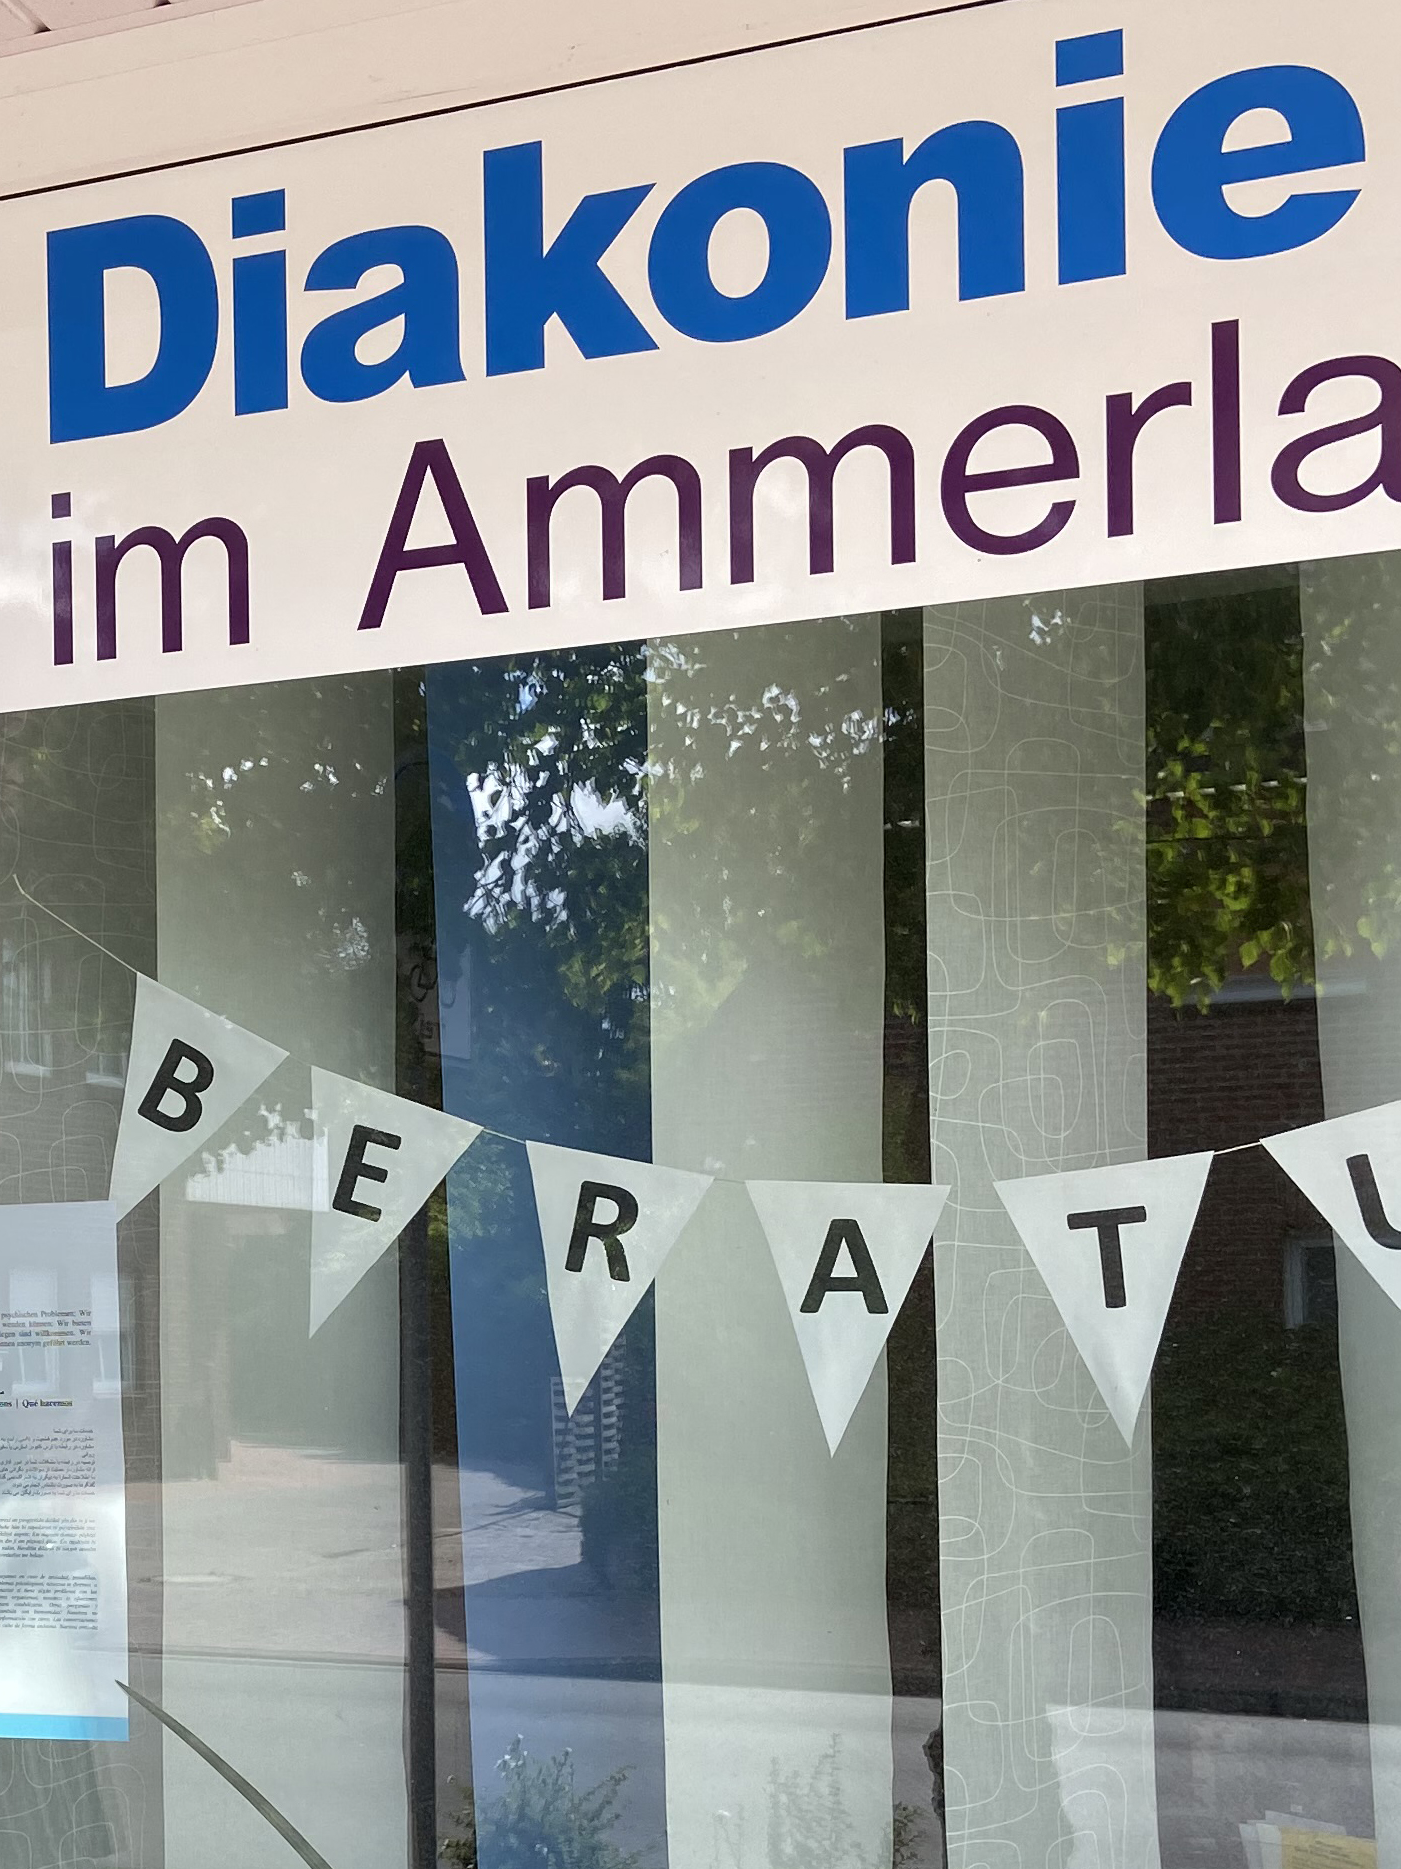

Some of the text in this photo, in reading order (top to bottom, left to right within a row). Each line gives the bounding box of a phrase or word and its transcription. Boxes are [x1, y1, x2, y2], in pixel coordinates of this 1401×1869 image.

[46, 28, 1366, 444] Diakonie
[51, 318, 1401, 667] im Ammerla
[22, 1399, 38, 1408] Qué
[40, 1399, 73, 1407] hacemos
